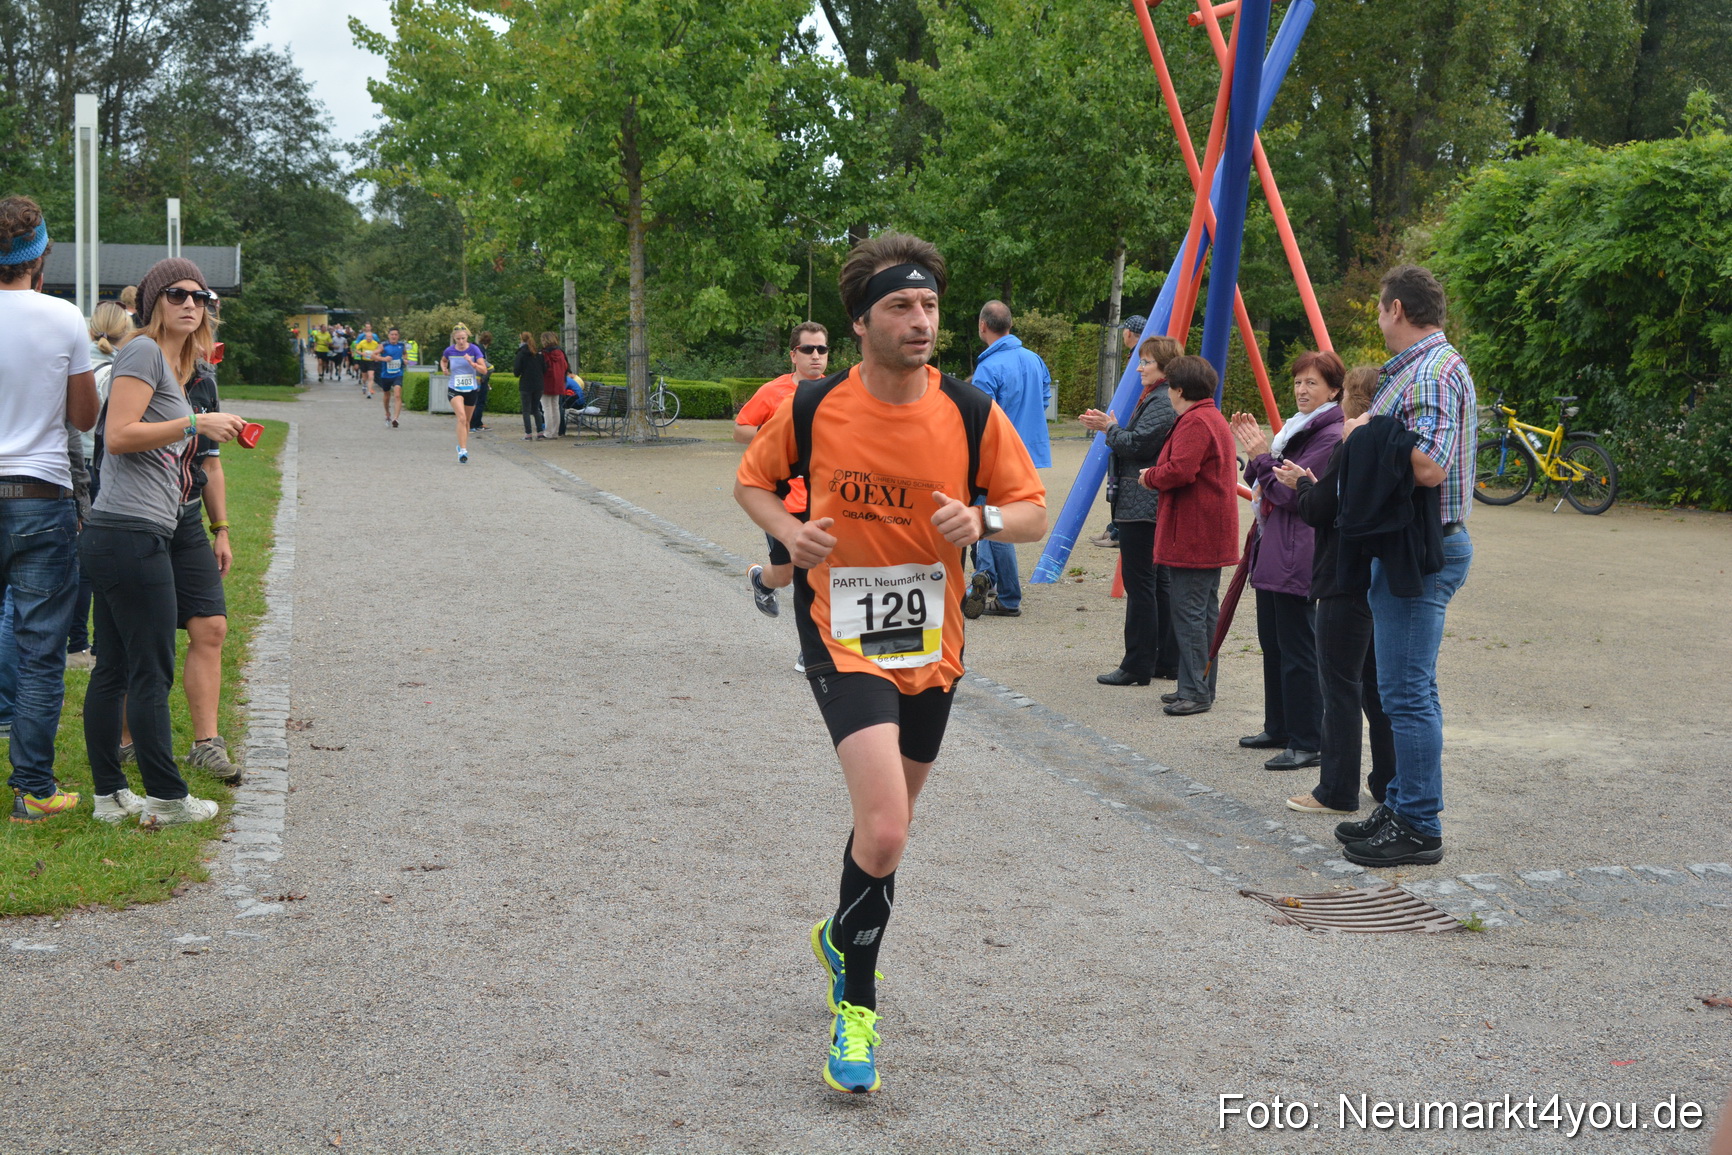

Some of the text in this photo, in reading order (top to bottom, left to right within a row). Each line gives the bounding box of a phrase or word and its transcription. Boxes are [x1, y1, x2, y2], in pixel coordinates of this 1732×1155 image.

[456, 378, 473, 386] 3403
[872, 475, 896, 484] UHREN
[897, 478, 912, 487] UND
[913, 481, 946, 490] SCHMUCK
[840, 481, 914, 510] OEXL
[842, 509, 912, 526] CIBA VISION
[832, 572, 926, 588] PARTL Neumarkt
[857, 588, 927, 631] 129
